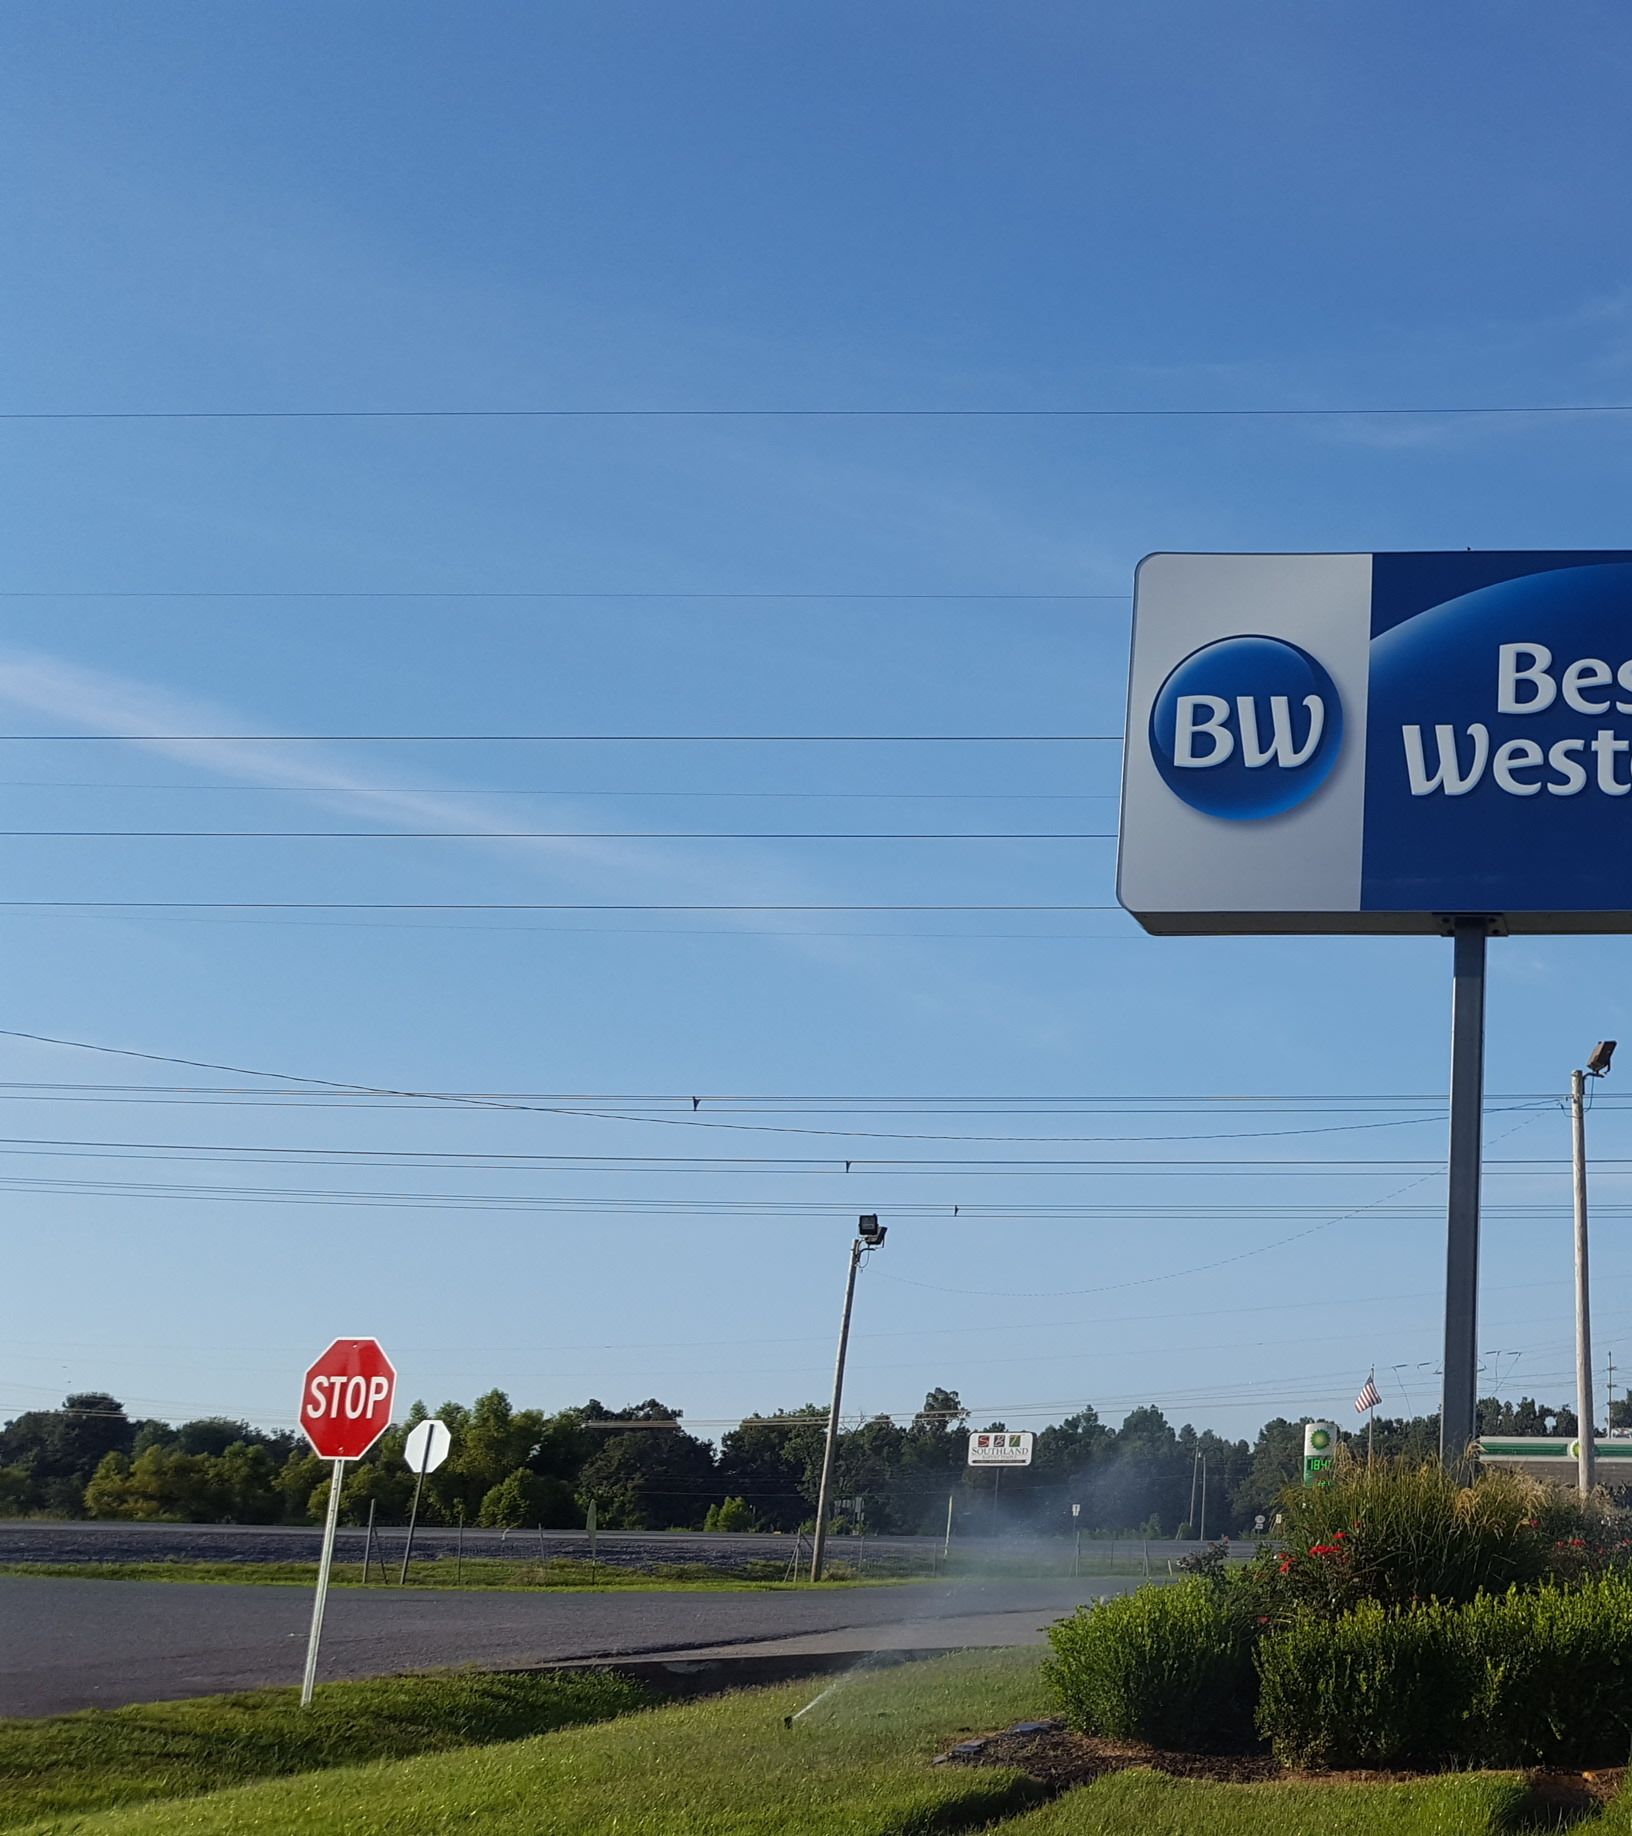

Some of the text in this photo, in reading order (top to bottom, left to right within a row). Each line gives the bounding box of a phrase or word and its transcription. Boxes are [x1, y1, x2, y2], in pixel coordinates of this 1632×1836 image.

[1173, 694, 1325, 768] BW
[306, 1375, 389, 1419] STOP
[971, 1447, 1029, 1456] SOUTHLAND
